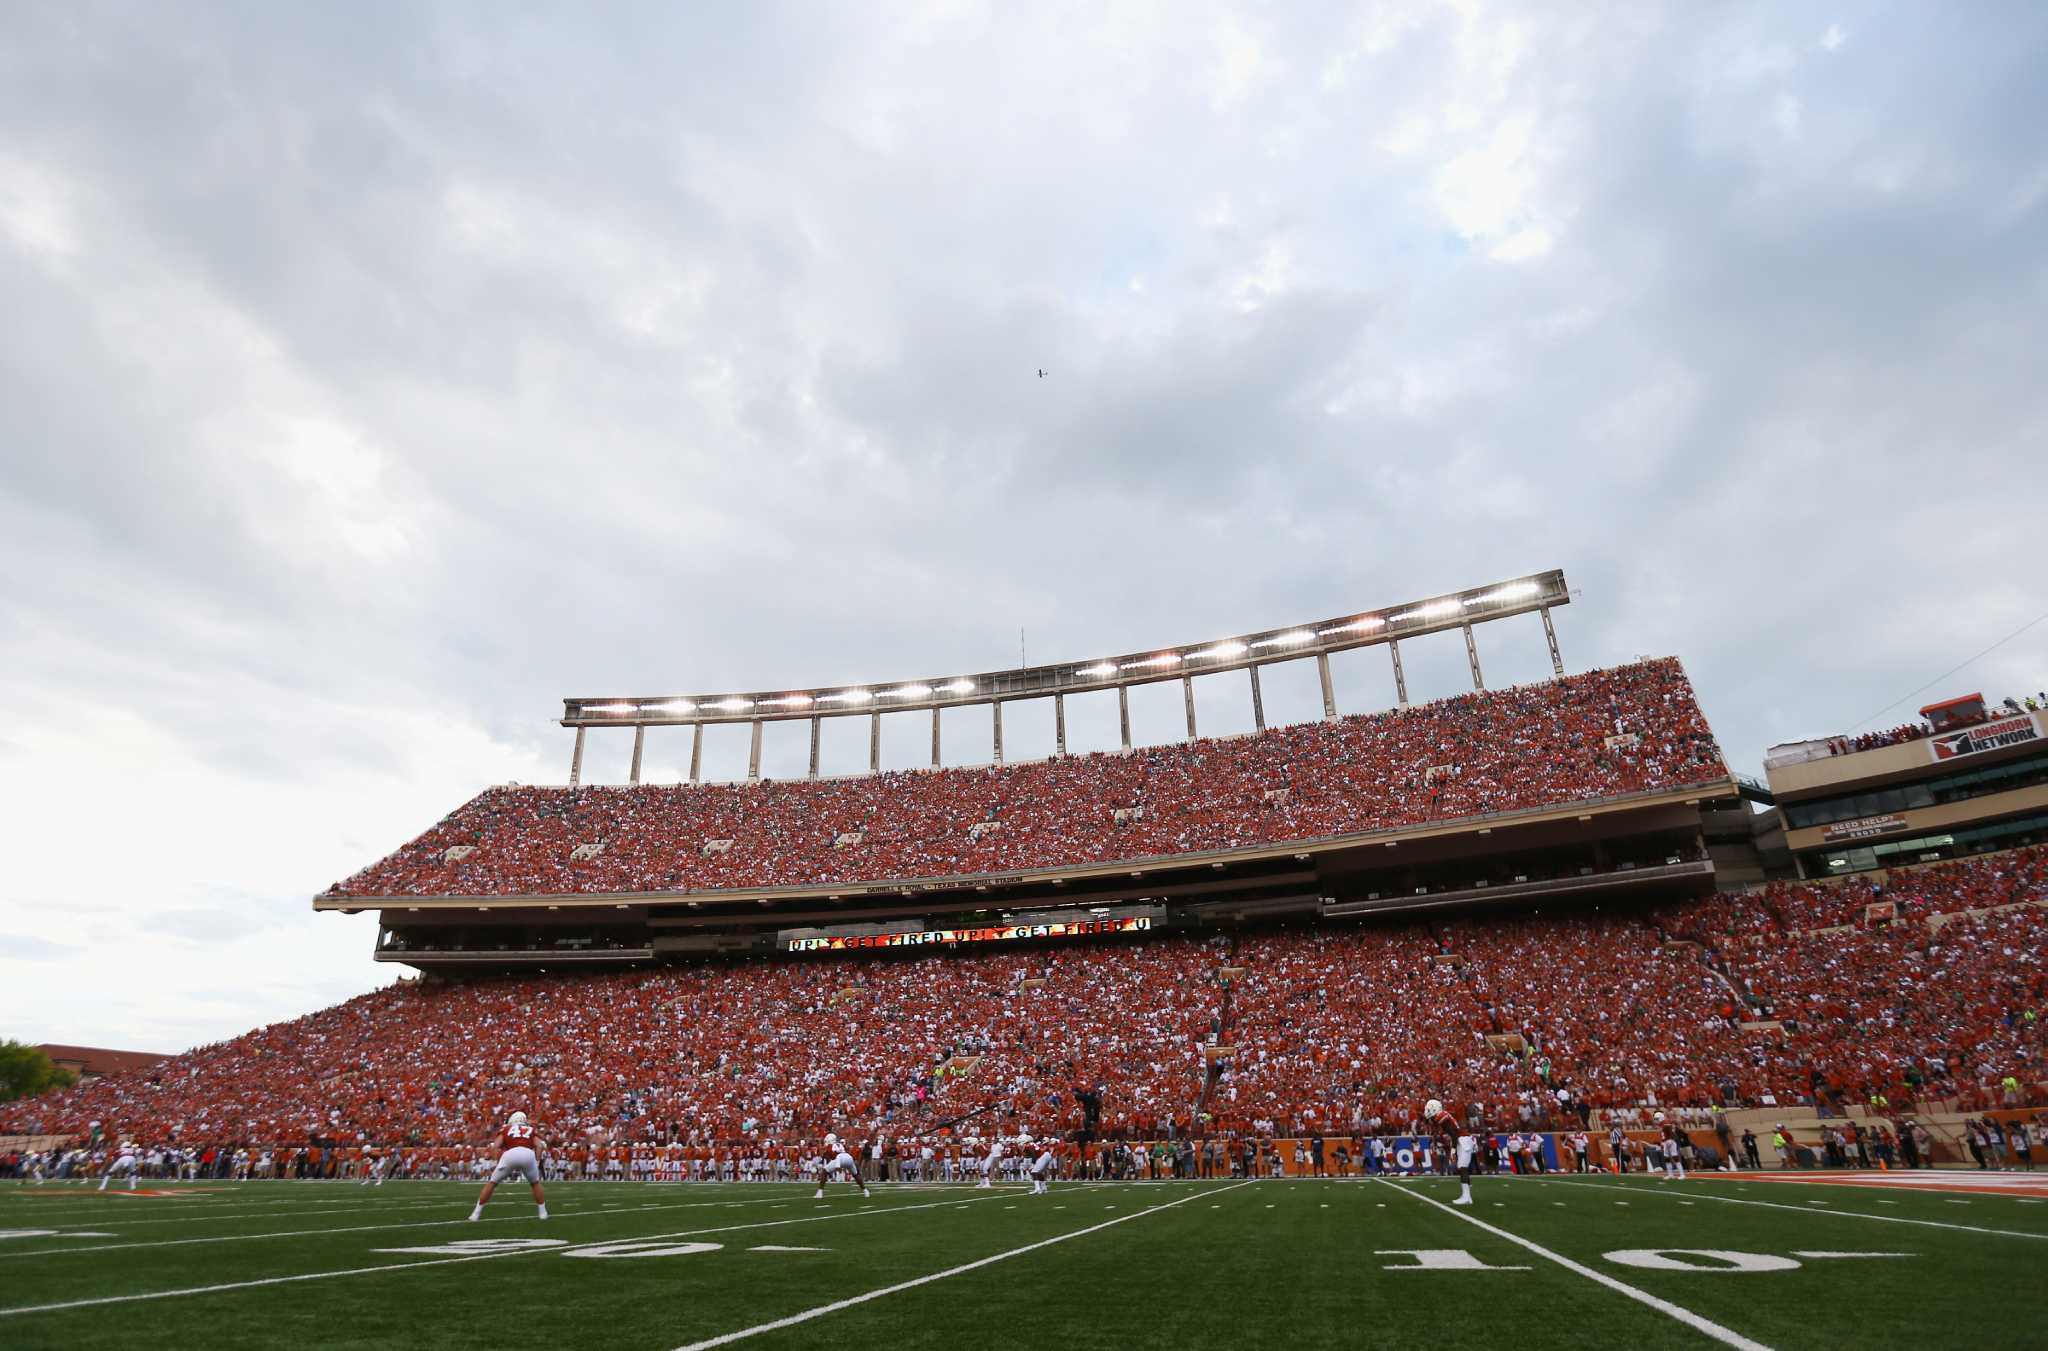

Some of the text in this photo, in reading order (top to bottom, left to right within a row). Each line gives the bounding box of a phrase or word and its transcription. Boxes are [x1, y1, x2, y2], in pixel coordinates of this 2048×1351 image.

[1968, 717, 2032, 740] LONGHORN
[1972, 728, 2037, 752] NETWORK
[1831, 821, 1858, 832] NEED
[934, 881, 956, 889] TEXAS
[844, 936, 878, 948] GET
[889, 932, 944, 946] FIRED
[1015, 925, 1053, 938] GET
[1065, 919, 1123, 935] FIRED
[1135, 918, 1147, 930] U
[507, 1124, 534, 1139] 47
